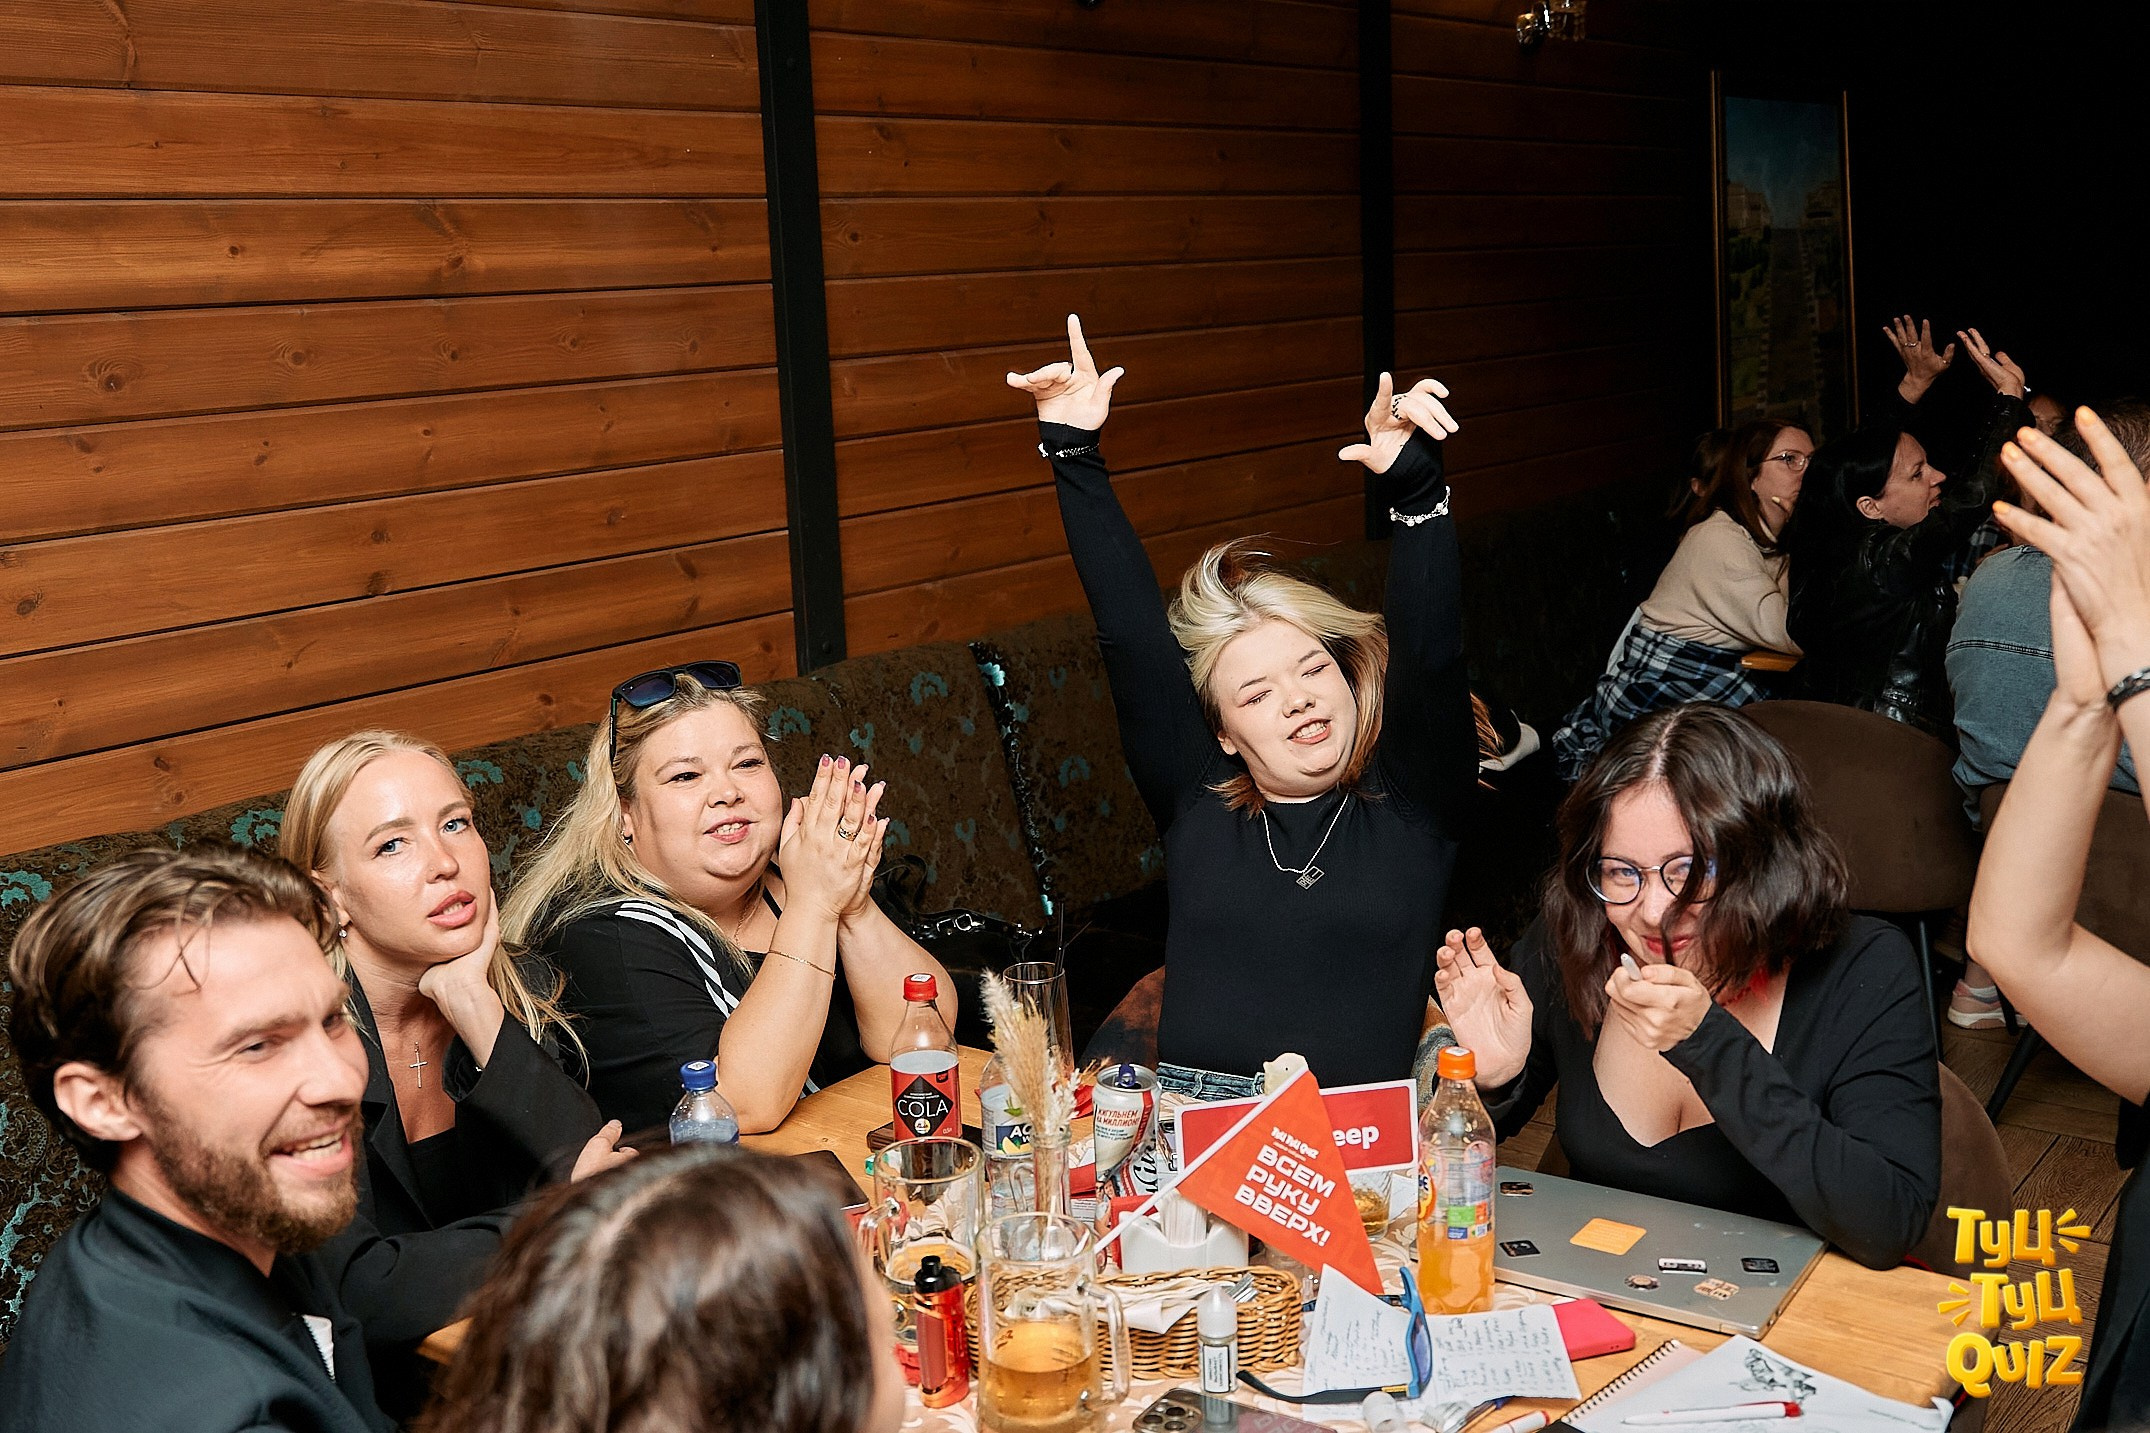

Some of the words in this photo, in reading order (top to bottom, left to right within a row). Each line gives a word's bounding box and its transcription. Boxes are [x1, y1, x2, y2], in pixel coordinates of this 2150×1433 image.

[897, 1099, 949, 1118] COLA
[1332, 1125, 1380, 1150] eep
[1245, 1164, 1320, 1215] РУКУ
[1257, 1144, 1336, 1198] ВСЕМ
[1234, 1184, 1331, 1247] ВВЕРХ!
